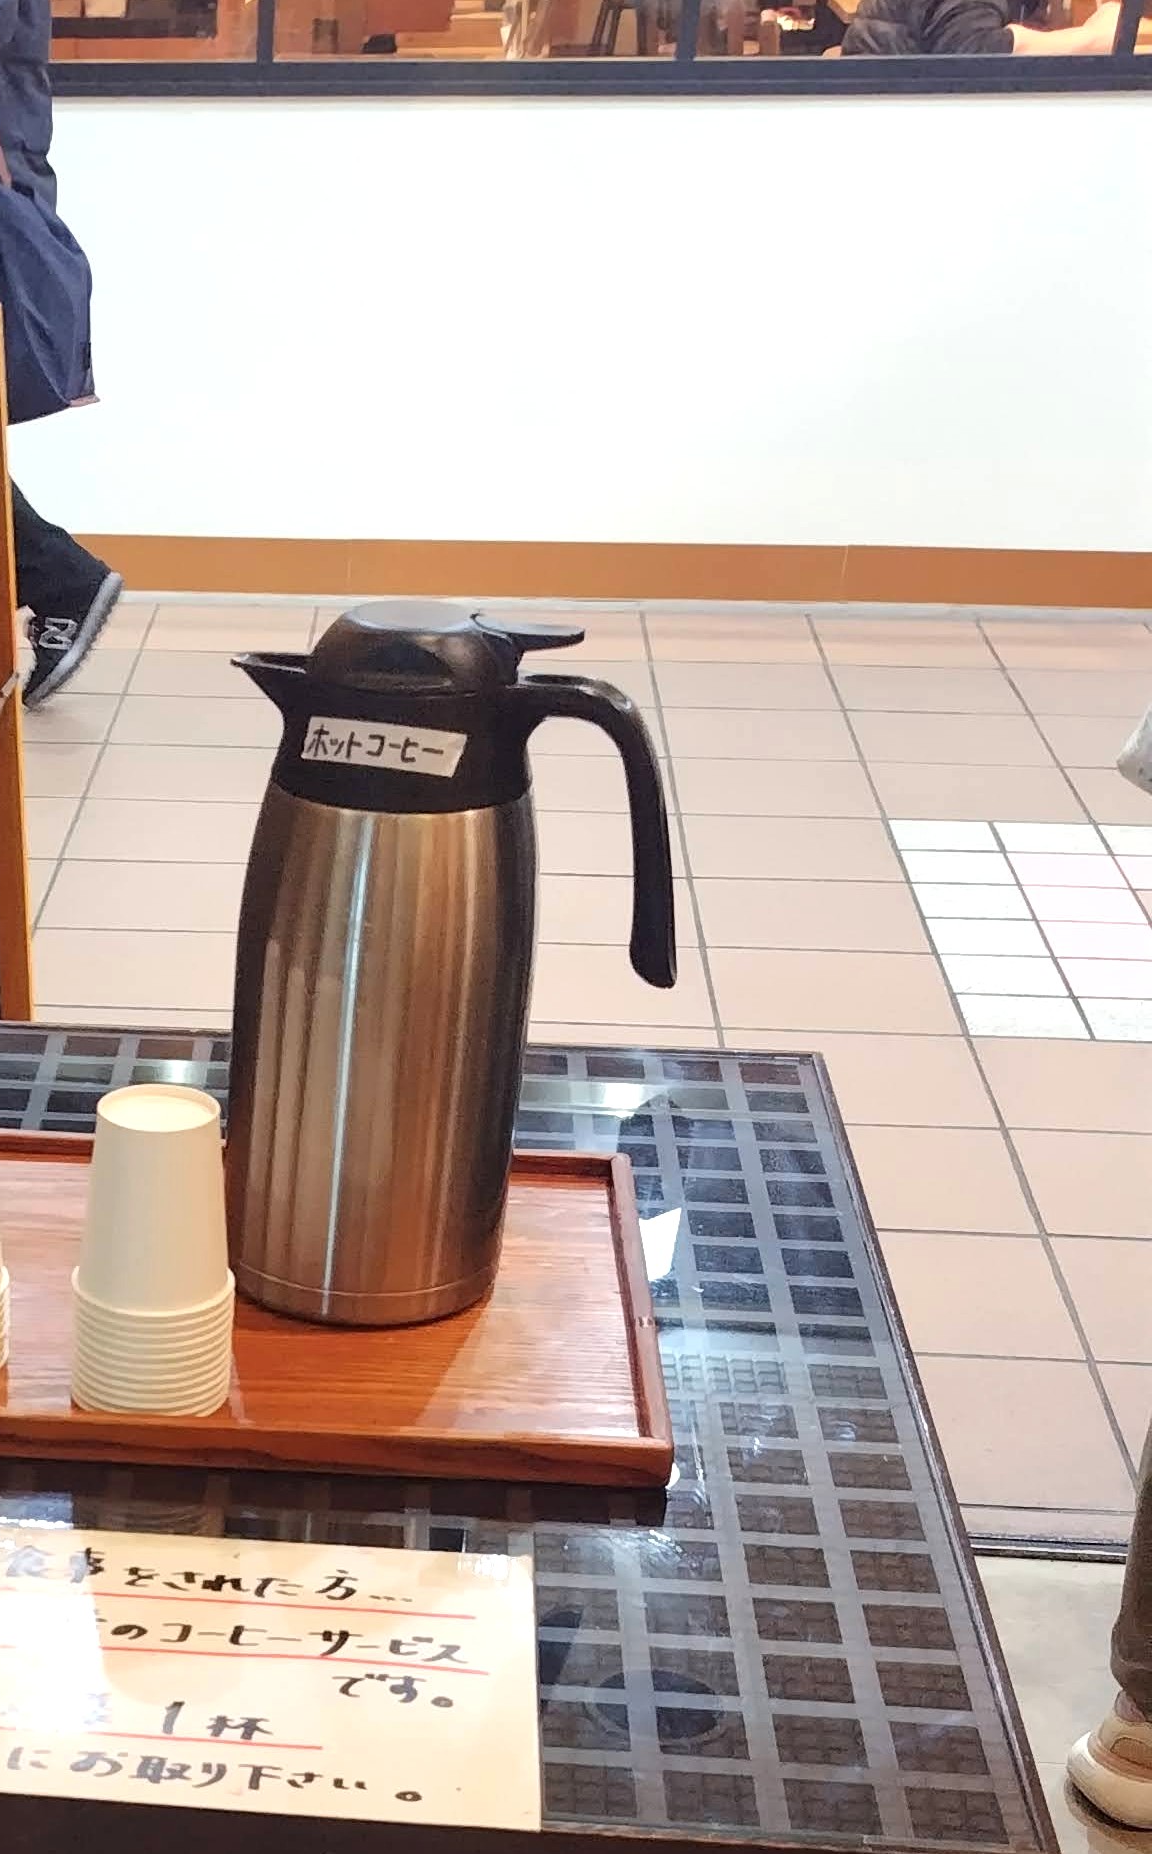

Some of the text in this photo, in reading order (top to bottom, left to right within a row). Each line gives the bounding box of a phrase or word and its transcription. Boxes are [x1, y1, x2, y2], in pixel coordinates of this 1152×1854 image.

[308, 724, 444, 763] ホットコーヒー
